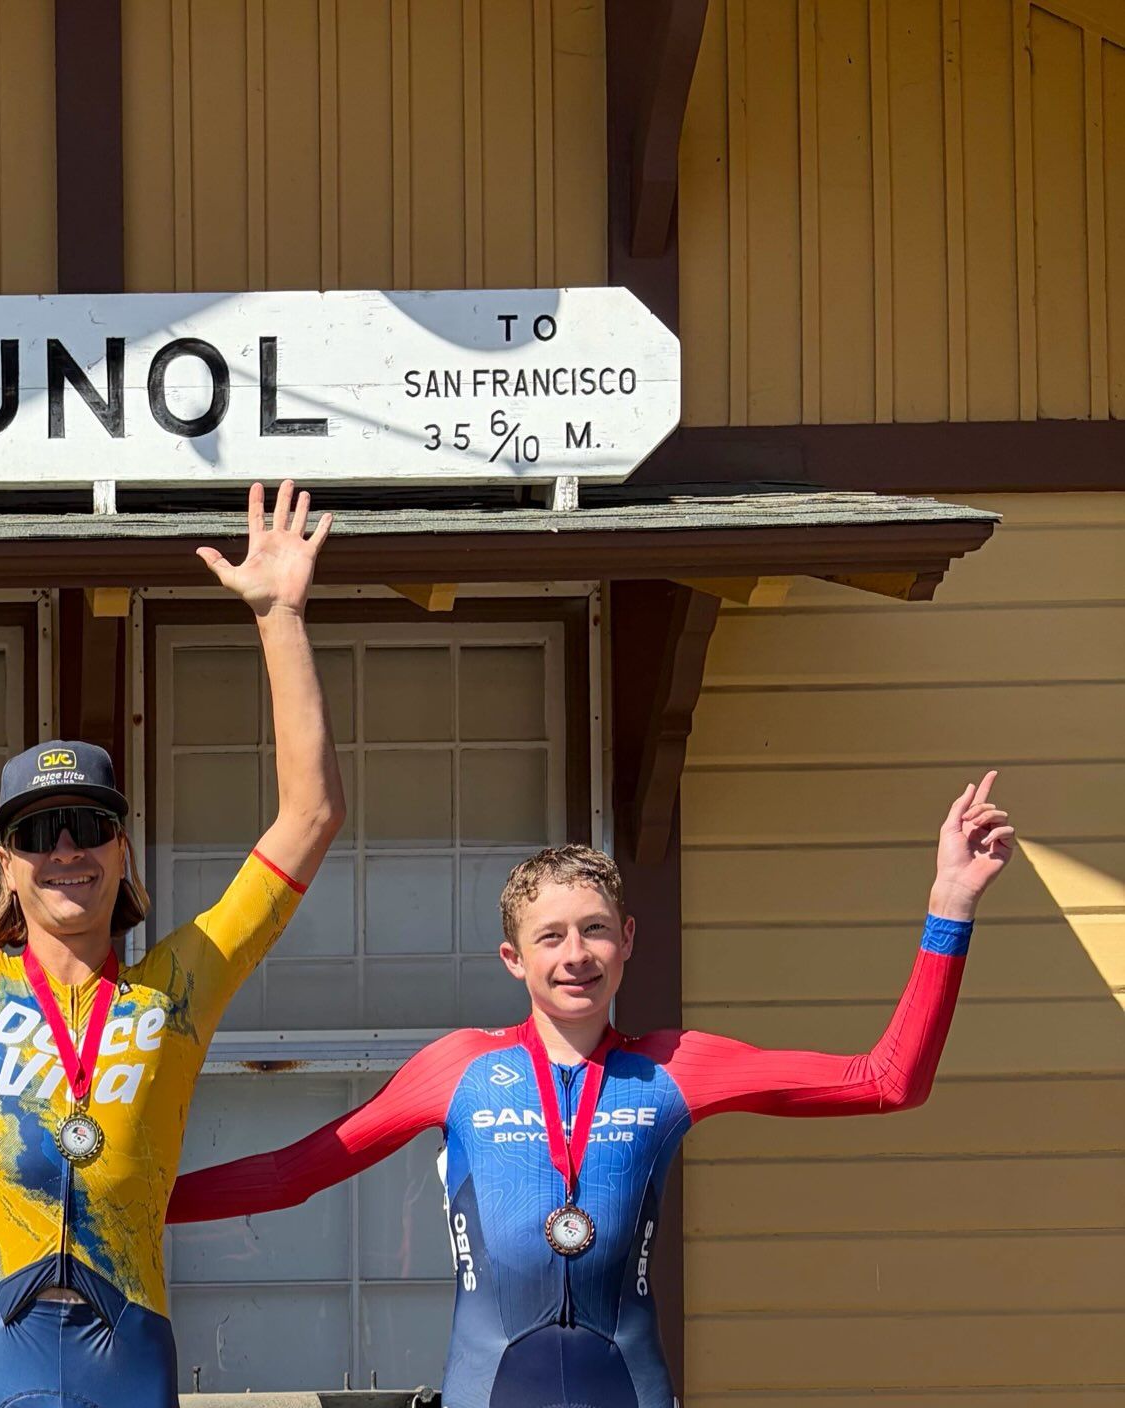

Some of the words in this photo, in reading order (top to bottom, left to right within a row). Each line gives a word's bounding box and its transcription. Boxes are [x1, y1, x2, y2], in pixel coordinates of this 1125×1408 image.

[498, 314, 557, 342] TO
[404, 369, 461, 398] SAN
[474, 367, 637, 397] FRANCISCO
[424, 424, 471, 450] 35
[32, 772, 62, 785] Dolce
[63, 771, 85, 781] Vita
[454, 1213, 477, 1292] SJBC
[636, 1220, 654, 1296] SJBC
